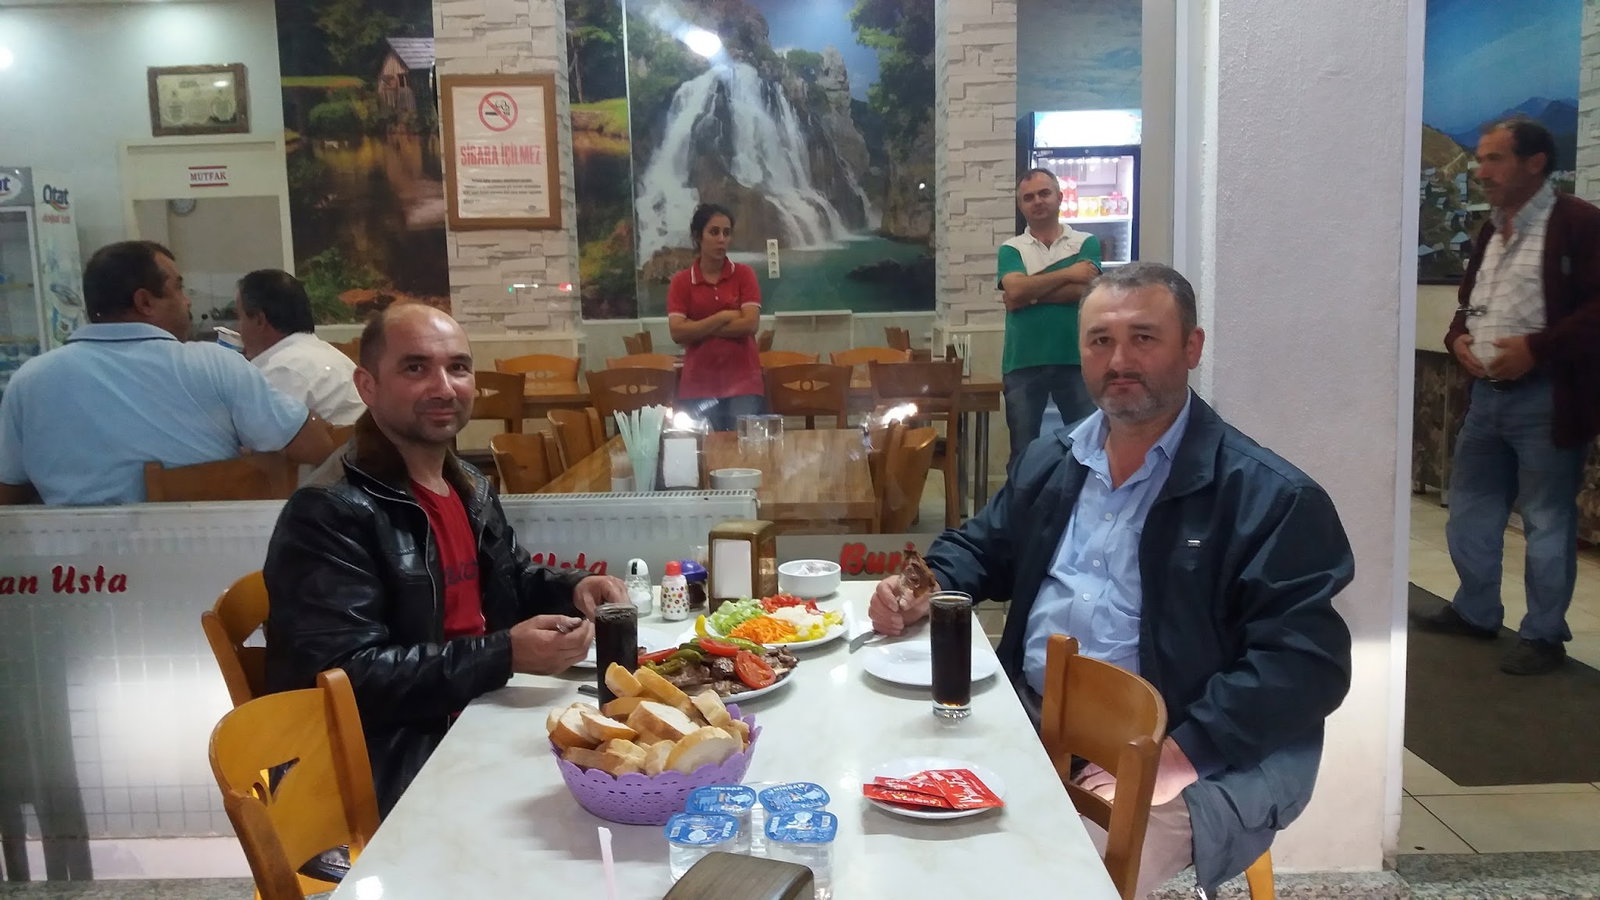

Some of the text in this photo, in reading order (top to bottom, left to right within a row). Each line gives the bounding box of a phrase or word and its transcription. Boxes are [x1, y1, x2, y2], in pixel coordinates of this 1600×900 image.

[461, 141, 542, 167] SİGARA İÇİLMEZ
[190, 172, 226, 182] MUTFAK
[840, 542, 915, 576] Bur
[52, 565, 127, 594] Usta
